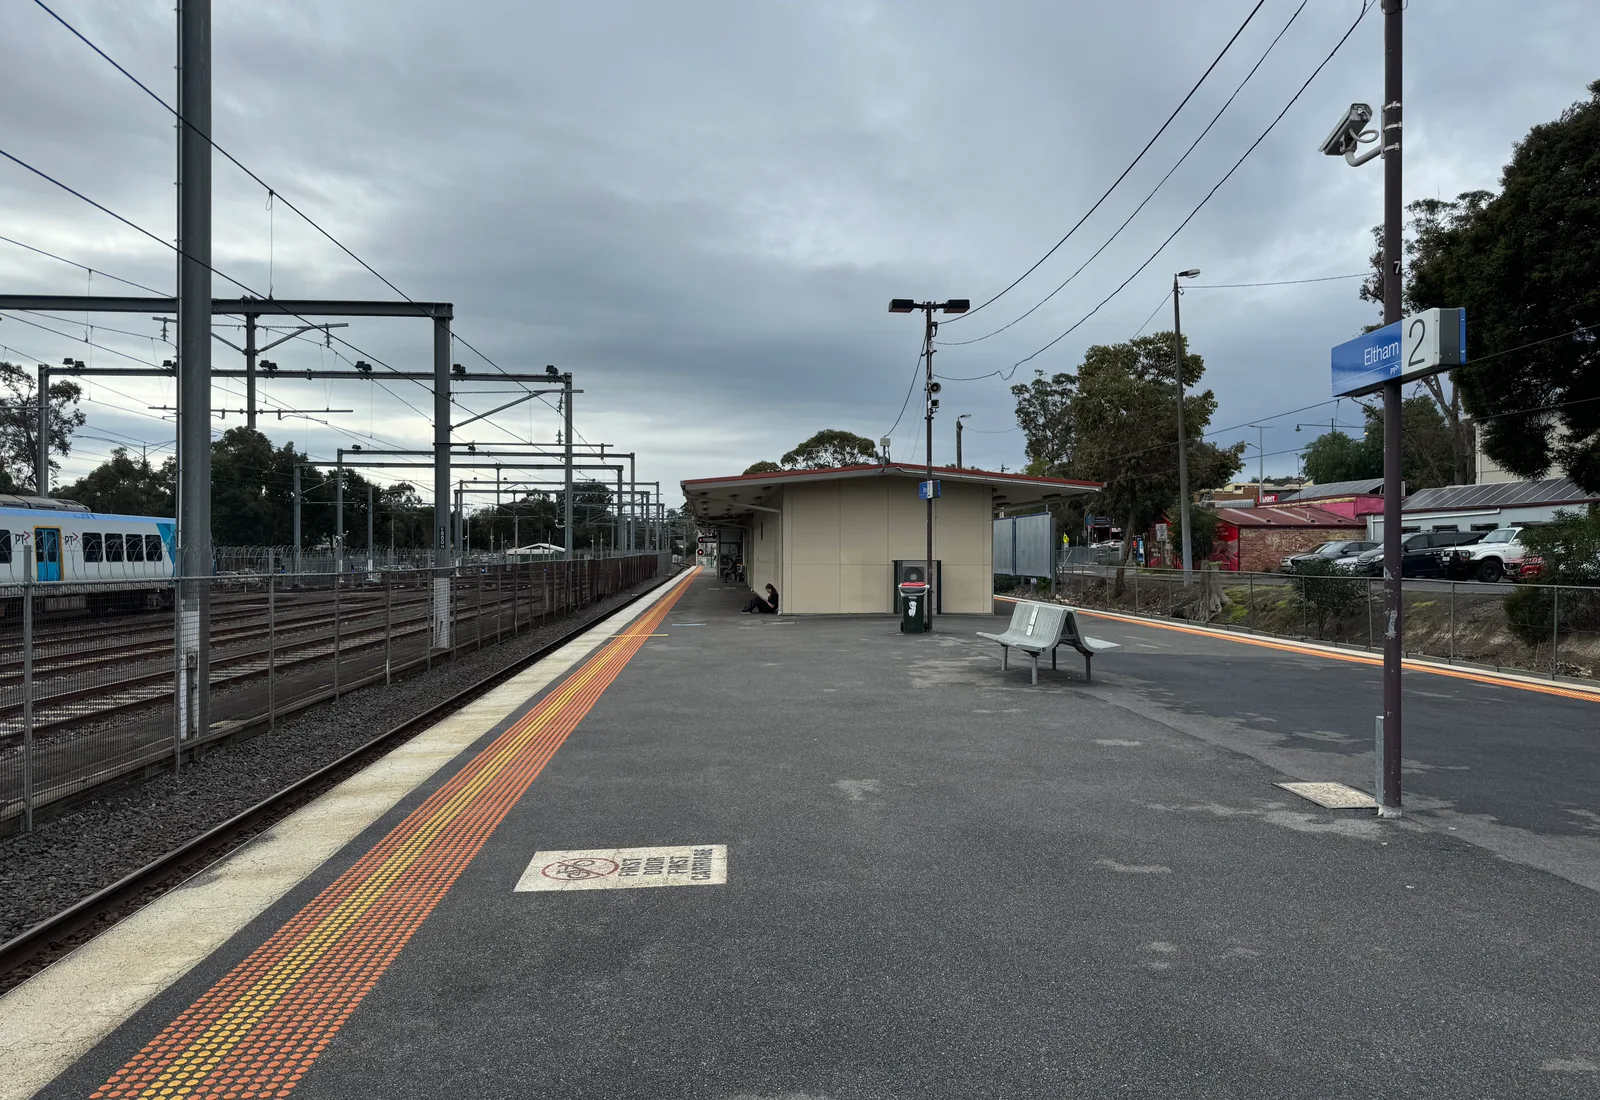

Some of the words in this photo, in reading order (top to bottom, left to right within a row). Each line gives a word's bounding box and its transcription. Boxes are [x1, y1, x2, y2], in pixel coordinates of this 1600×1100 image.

[1393, 260, 1401, 274] 7
[1407, 318, 1426, 368] 2
[1364, 341, 1399, 366] Eltham
[618, 857, 642, 877] FIRST
[643, 856, 665, 875] DOOR
[667, 855, 690, 874] FIRST
[690, 848, 713, 881] CARRIAGE
